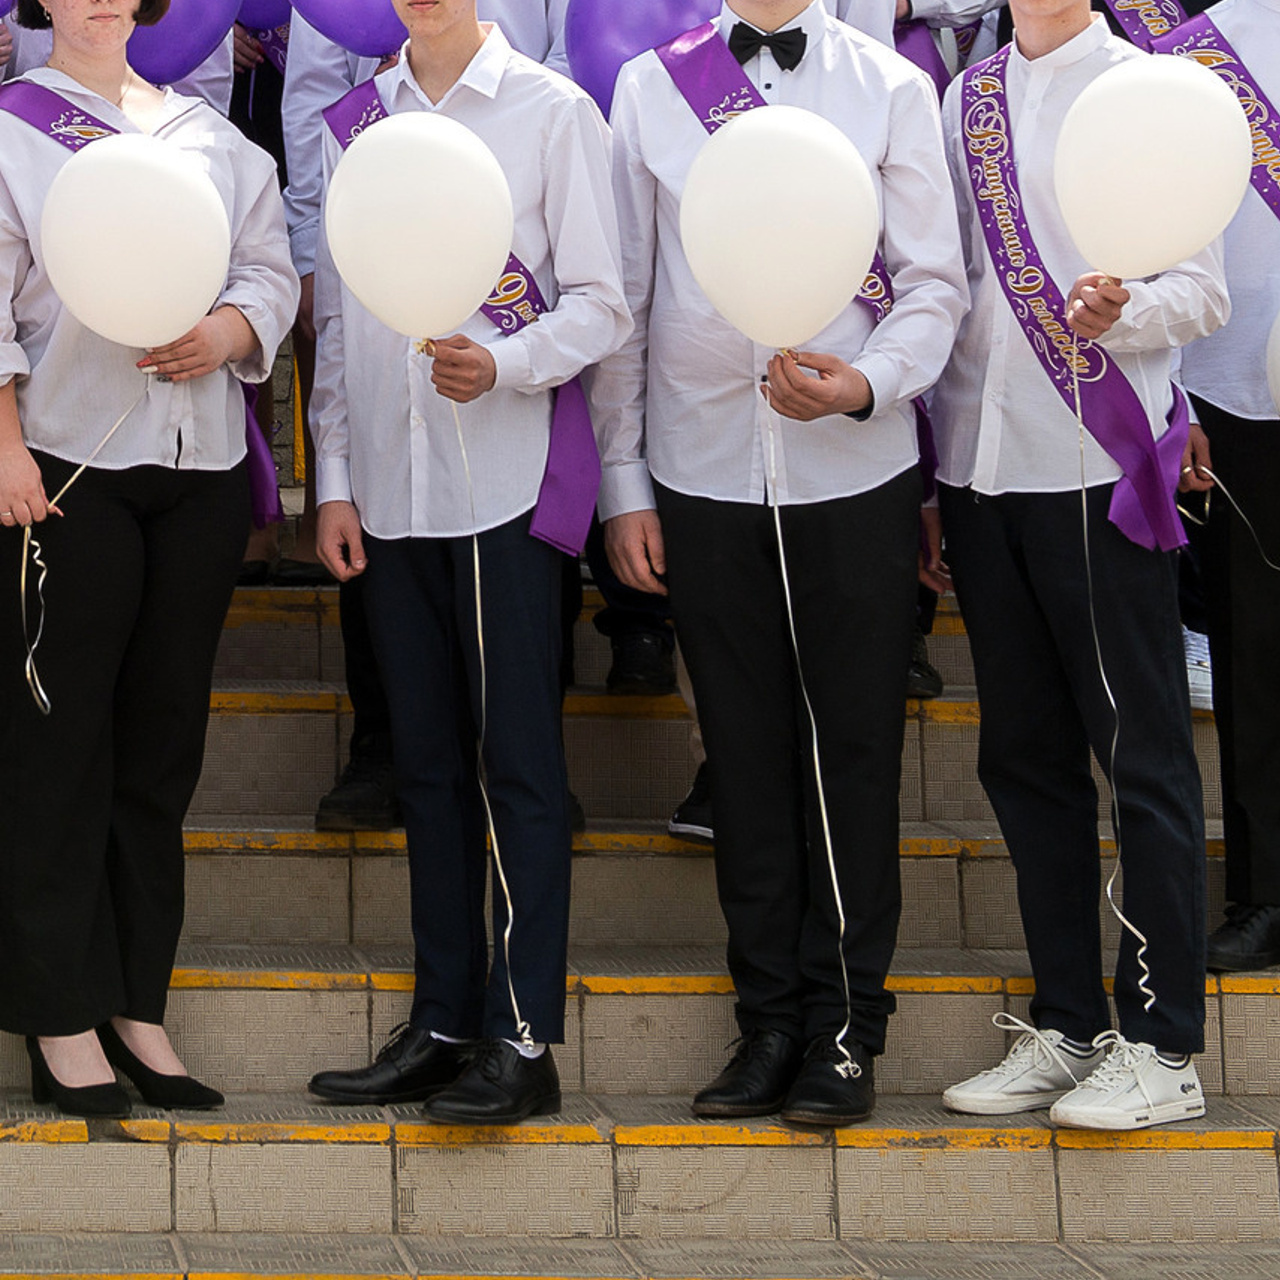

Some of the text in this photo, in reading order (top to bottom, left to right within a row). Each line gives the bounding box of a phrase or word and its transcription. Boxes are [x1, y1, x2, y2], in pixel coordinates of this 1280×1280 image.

[484, 271, 529, 307] 9
[964, 96, 1091, 374] Выпускник 9 класса
